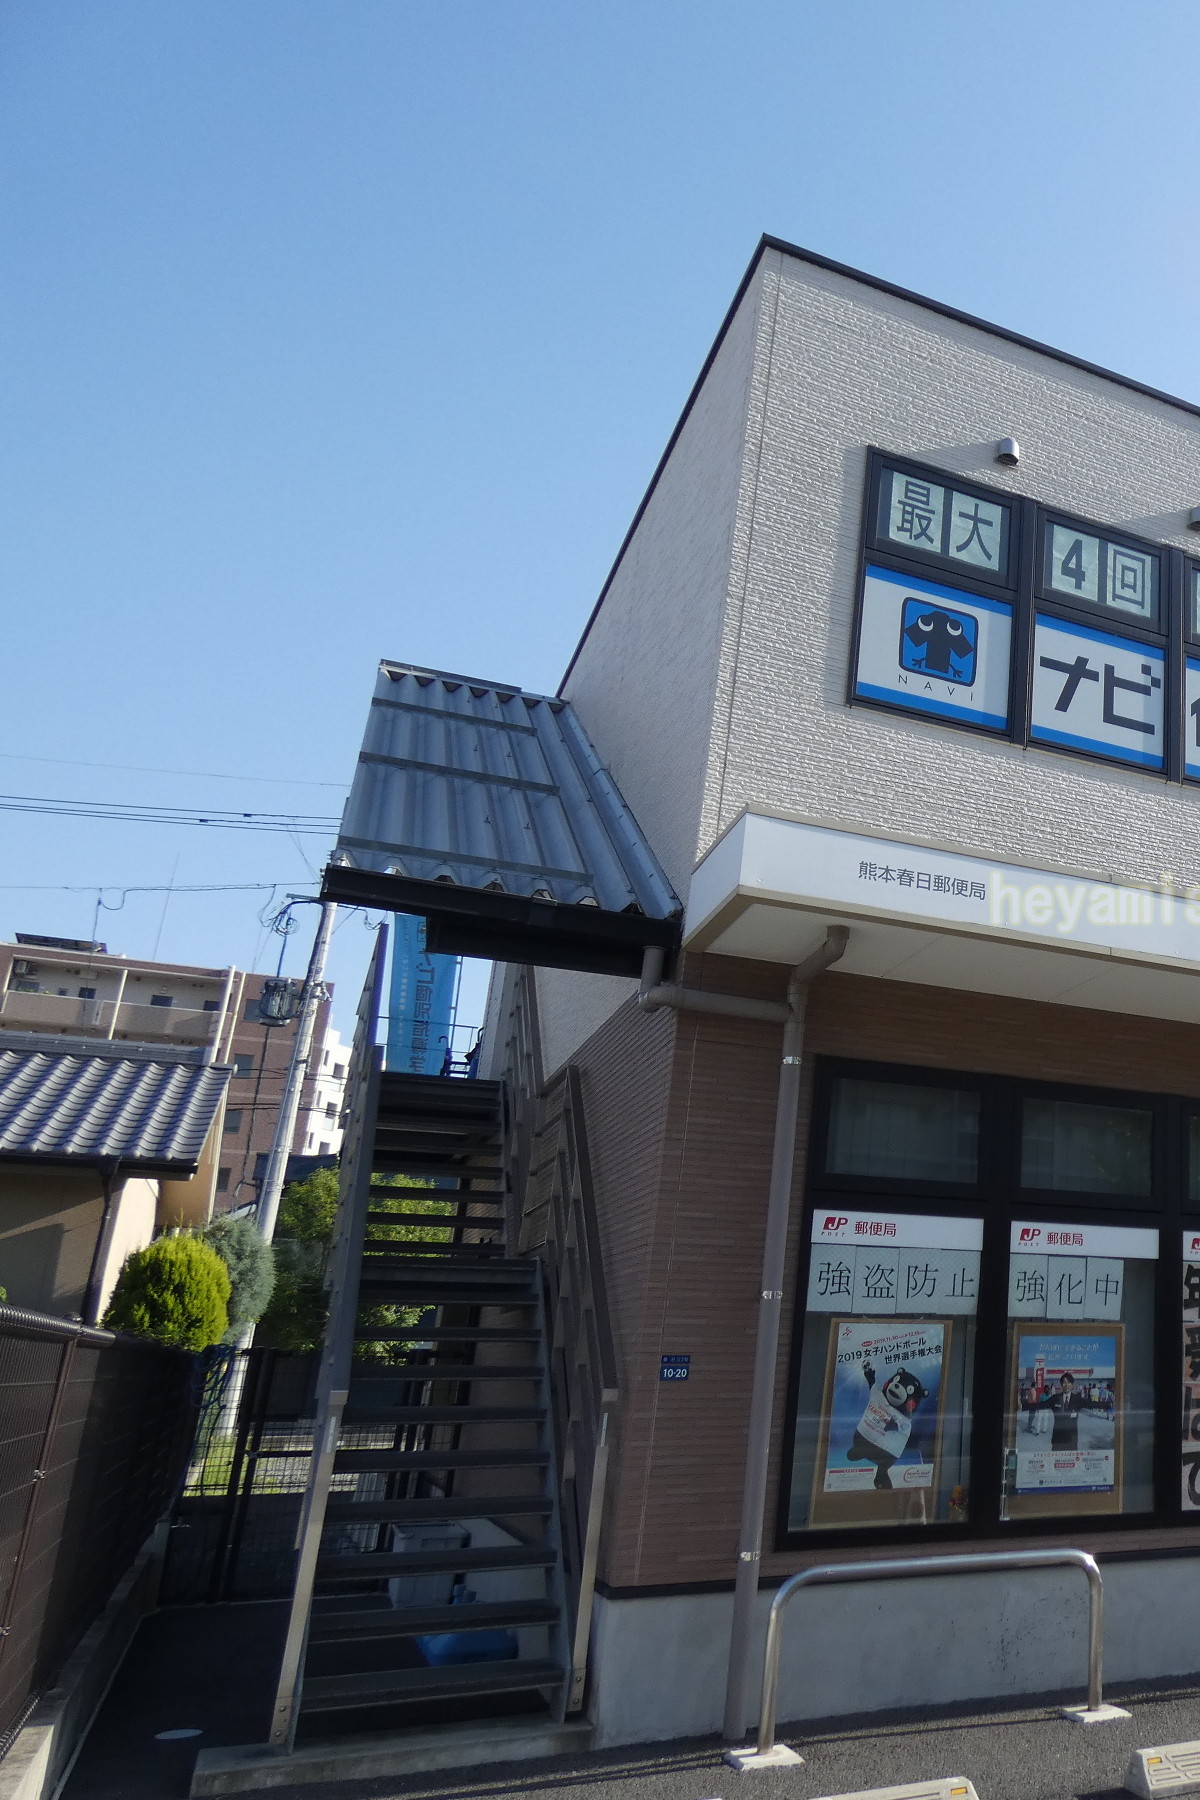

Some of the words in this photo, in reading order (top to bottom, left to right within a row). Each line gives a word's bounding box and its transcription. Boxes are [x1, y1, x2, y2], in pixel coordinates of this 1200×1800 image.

[896, 479, 994, 562] 最大
[1060, 538, 1146, 610] 4回
[898, 674, 974, 702] NAVI
[1039, 655, 1161, 735] ナビ
[858, 861, 986, 901] 熊本春日郵便局
[855, 1221, 897, 1237] 郵便局
[1047, 1232, 1084, 1246] 郵便局
[817, 1261, 976, 1299] 強盗防止
[1016, 1270, 1119, 1306] 強化中
[884, 1344, 942, 1365] 世界選手権大会
